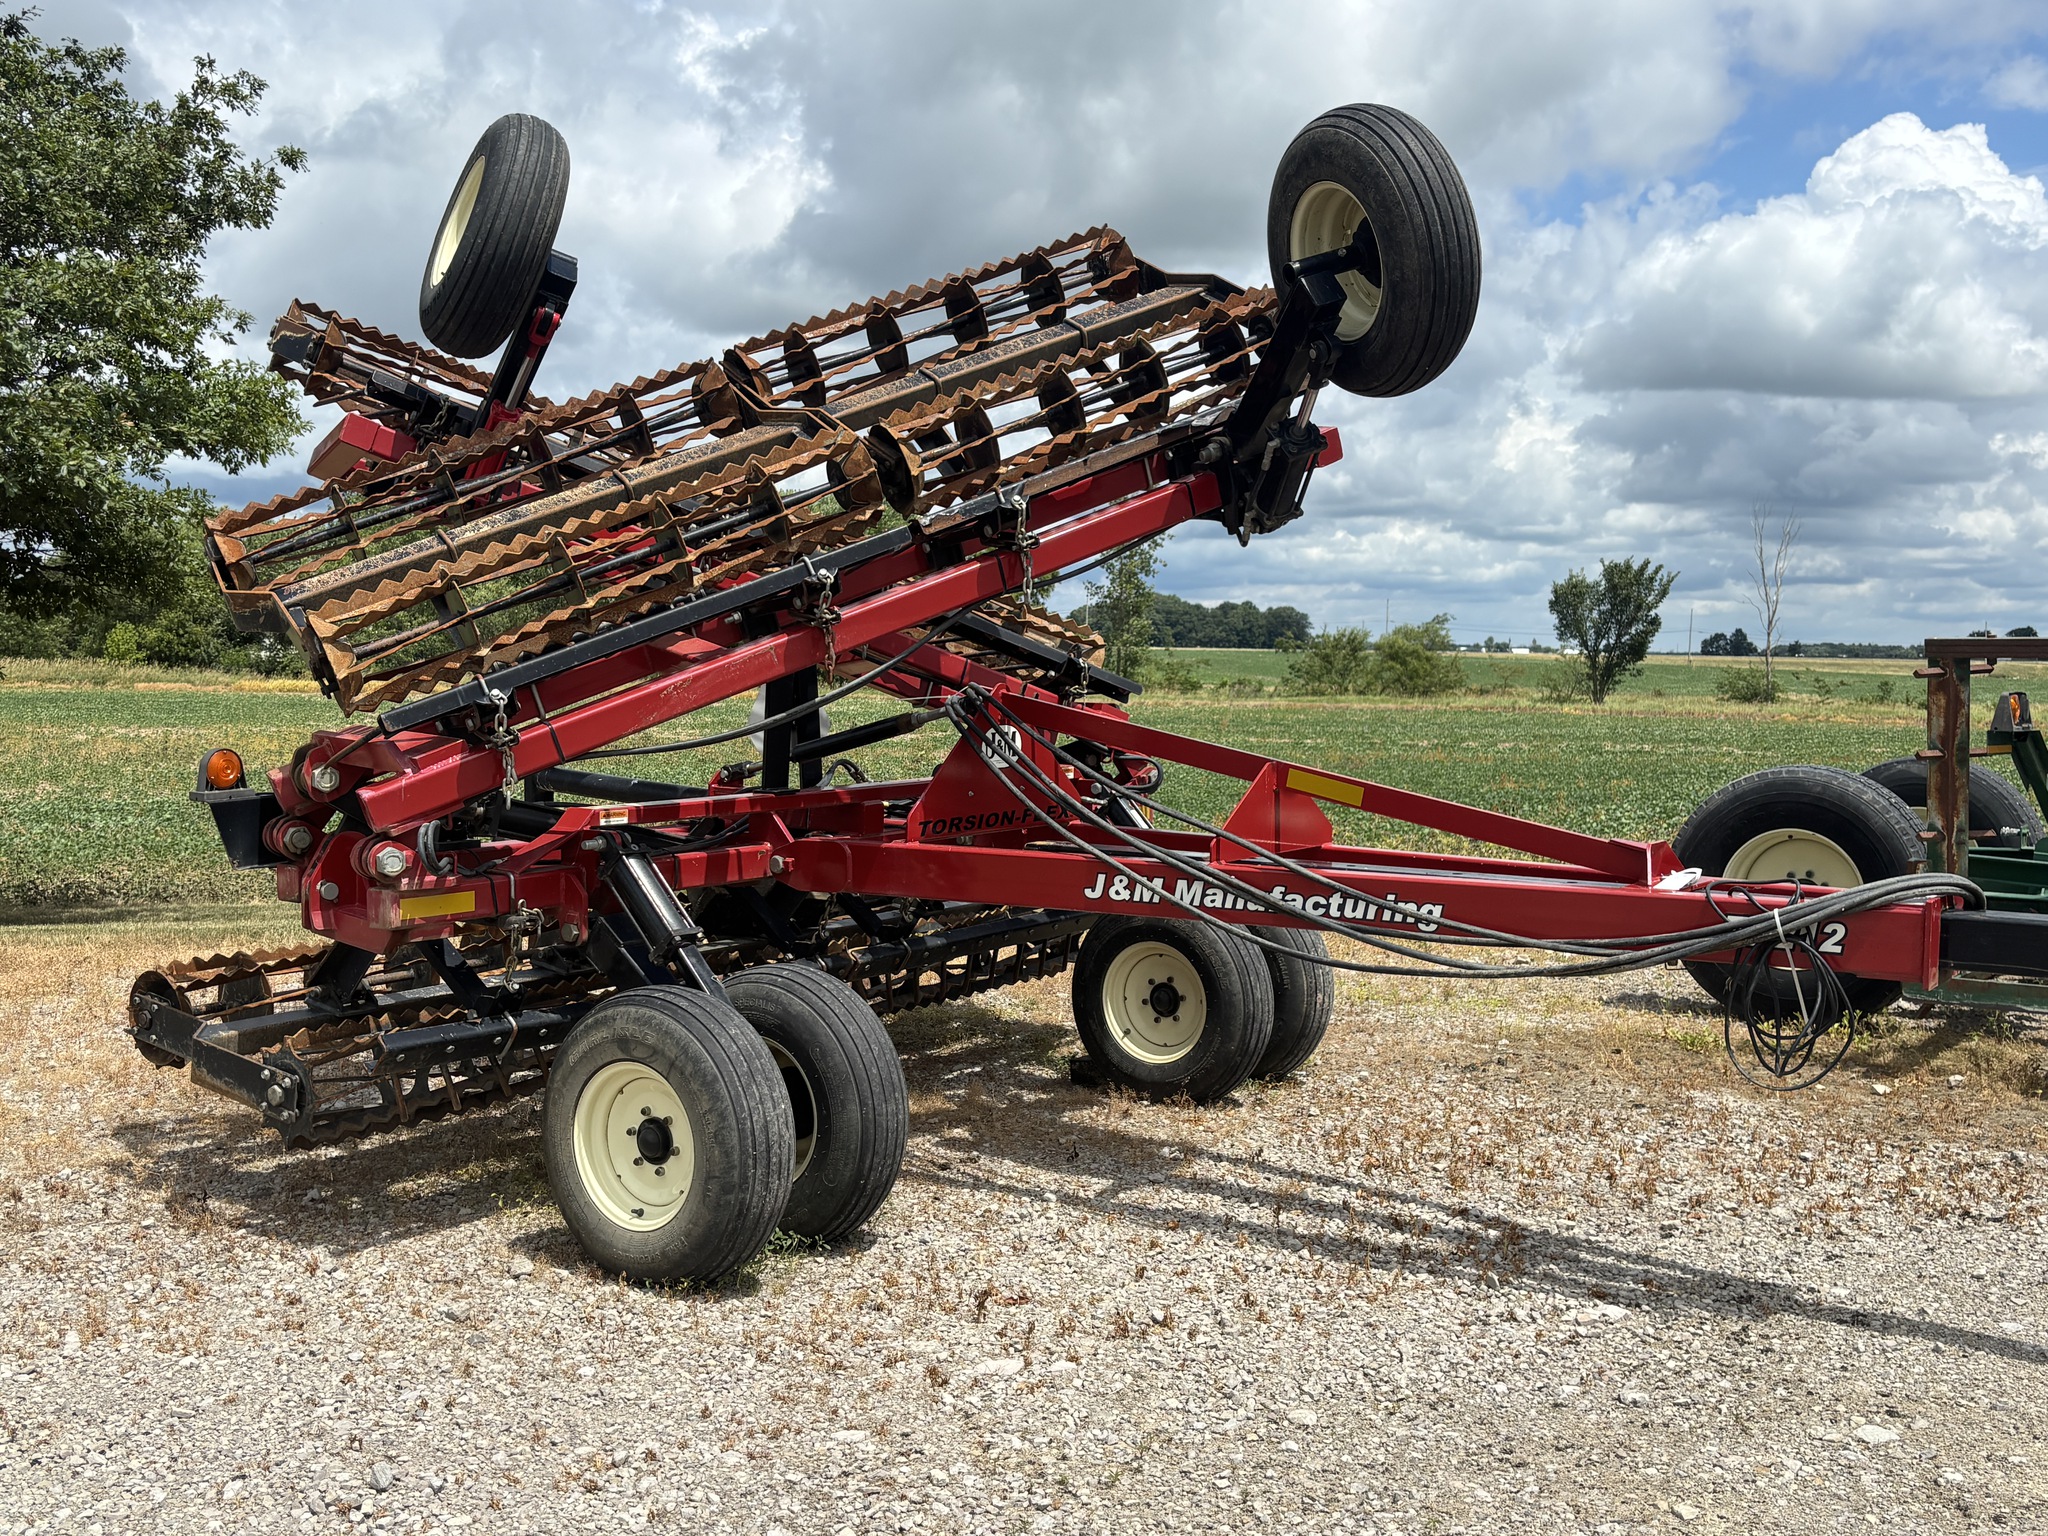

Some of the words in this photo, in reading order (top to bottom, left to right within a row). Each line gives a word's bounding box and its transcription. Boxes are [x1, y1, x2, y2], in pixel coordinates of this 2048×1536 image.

[1083, 873, 1164, 904] J&M
[734, 997, 783, 1014] SPECIALIST
[568, 1026, 656, 1066] CARLISLE
